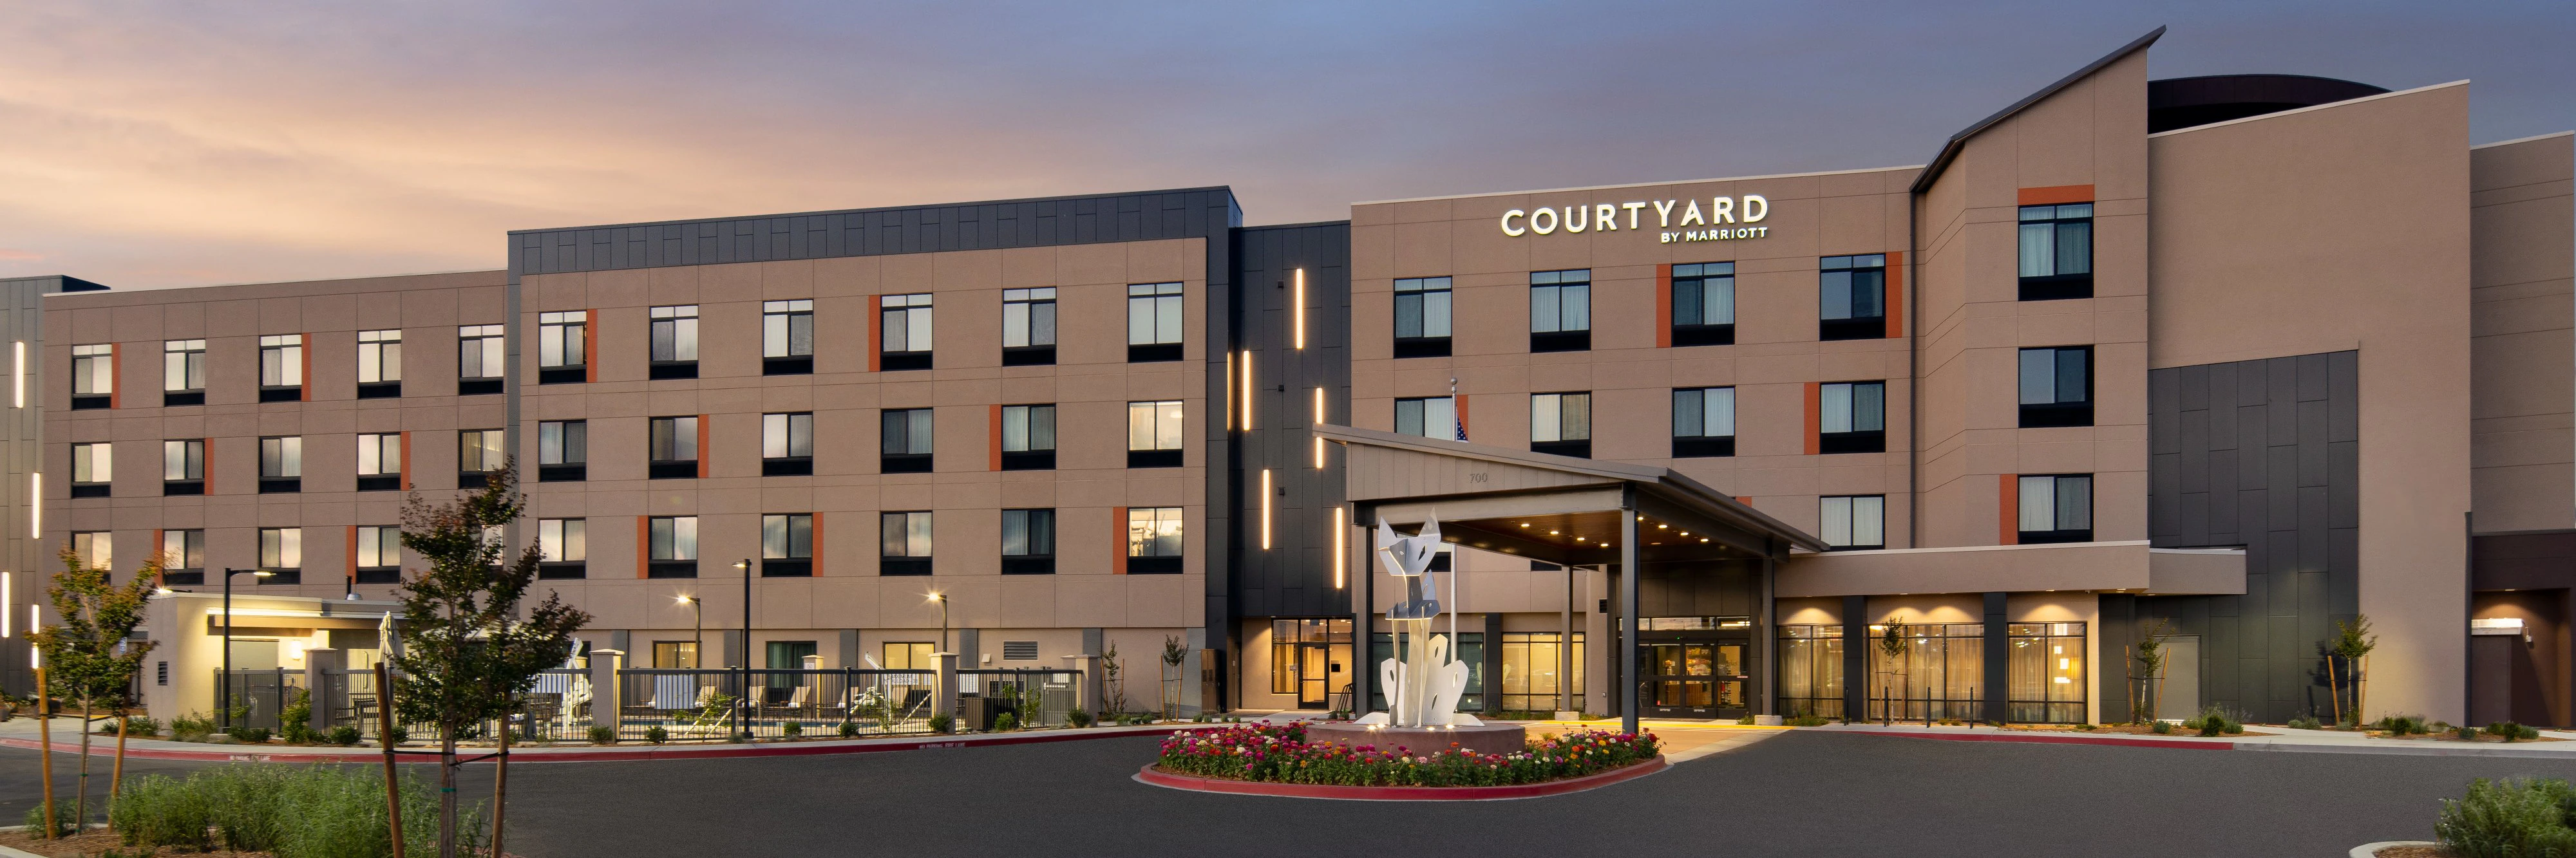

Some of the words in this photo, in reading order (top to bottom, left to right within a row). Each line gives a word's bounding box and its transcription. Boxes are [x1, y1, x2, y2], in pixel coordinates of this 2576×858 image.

[1501, 195, 1768, 236] COURTYARD
[1661, 232, 1680, 243] BY
[1686, 227, 1768, 242] MARRIOTT
[1470, 473, 1488, 483] 700
